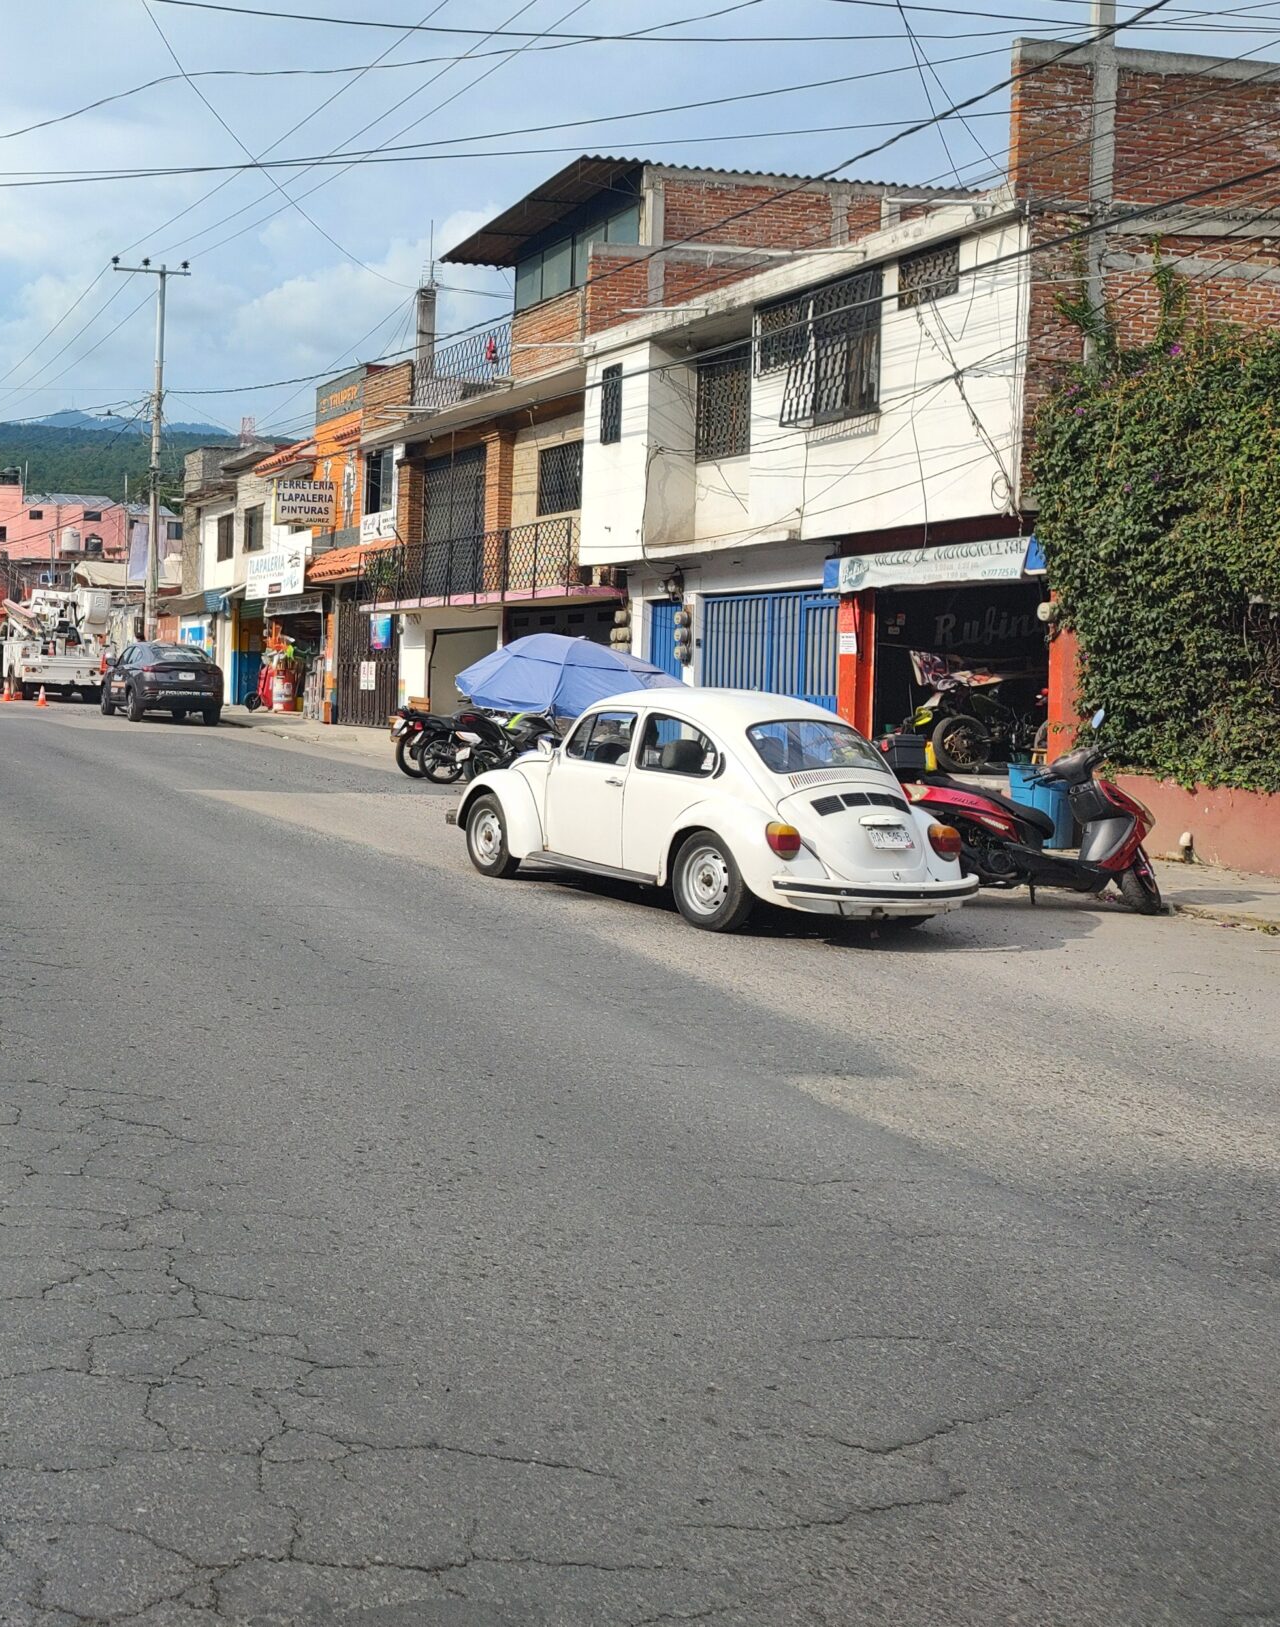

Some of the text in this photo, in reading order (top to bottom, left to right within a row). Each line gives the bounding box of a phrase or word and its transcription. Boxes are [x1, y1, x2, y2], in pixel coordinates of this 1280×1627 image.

[277, 480, 334, 491] FERRETERIA
[277, 492, 334, 503] TLAPALERIA
[281, 505, 329, 515] PINTURAS
[874, 551, 911, 567] TALLER
[913, 548, 930, 567] DE
